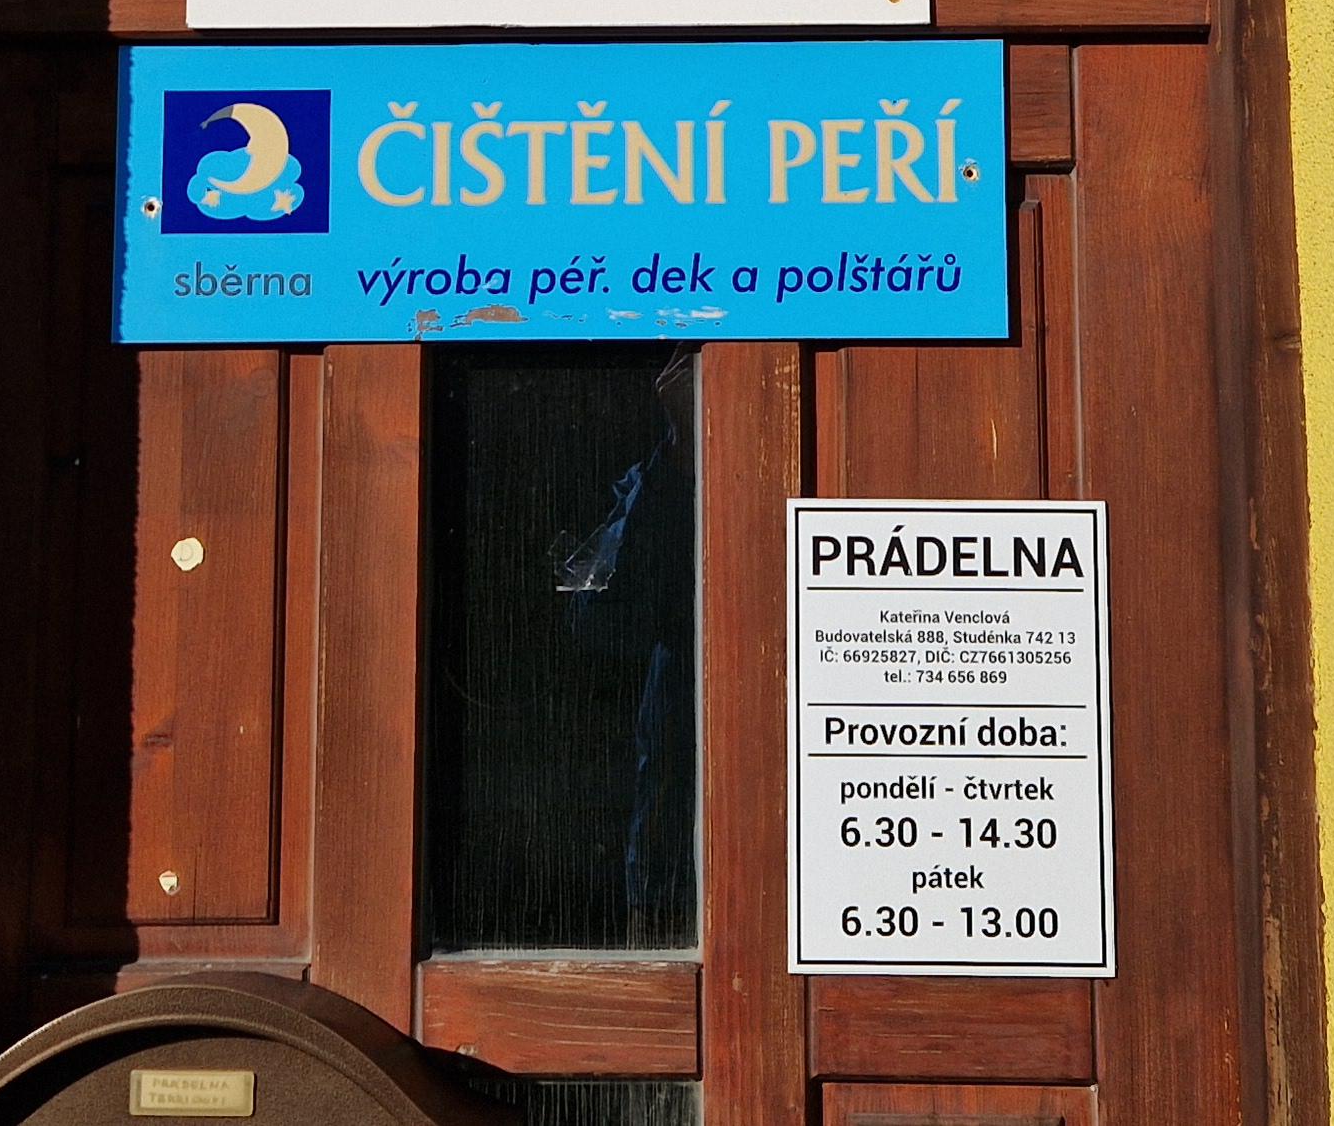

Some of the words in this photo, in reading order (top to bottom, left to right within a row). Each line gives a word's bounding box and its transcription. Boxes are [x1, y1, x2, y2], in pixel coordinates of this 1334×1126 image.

[358, 100, 731, 206] ČIŠTĚNÍ
[770, 99, 964, 205] PEŘÍ
[175, 263, 311, 297] sběrna
[358, 255, 508, 305] výroba
[529, 257, 610, 303] péř.
[632, 254, 711, 294] dek
[731, 266, 757, 293] a
[777, 252, 961, 302] polštářů
[812, 525, 1084, 578] PRÁDELNA
[880, 610, 940, 624] Kateřina
[944, 610, 1010, 625] Venclová
[815, 629, 913, 644] Budovatelská
[917, 630, 948, 647] 888,
[1026, 631, 1054, 645] 742
[1059, 632, 1076, 645] 13
[820, 647, 839, 663] IČ:
[843, 650, 921, 665] 66925827,
[925, 647, 955, 664] DIČ:
[960, 650, 1072, 664] CZ7661305256
[884, 669, 911, 683] tel.:
[916, 670, 943, 684] 734
[948, 670, 975, 684] 656
[979, 670, 1007, 684] 869
[825, 717, 968, 746] Provozní
[977, 718, 1067, 747] doba:
[840, 775, 938, 804] pondělí
[964, 776, 1054, 800] čtvrtek
[841, 817, 917, 847] 6.30
[960, 818, 1057, 849] 14.30
[912, 865, 984, 893] pátek
[842, 907, 918, 936] 6.30
[961, 907, 1058, 938] 13.00
